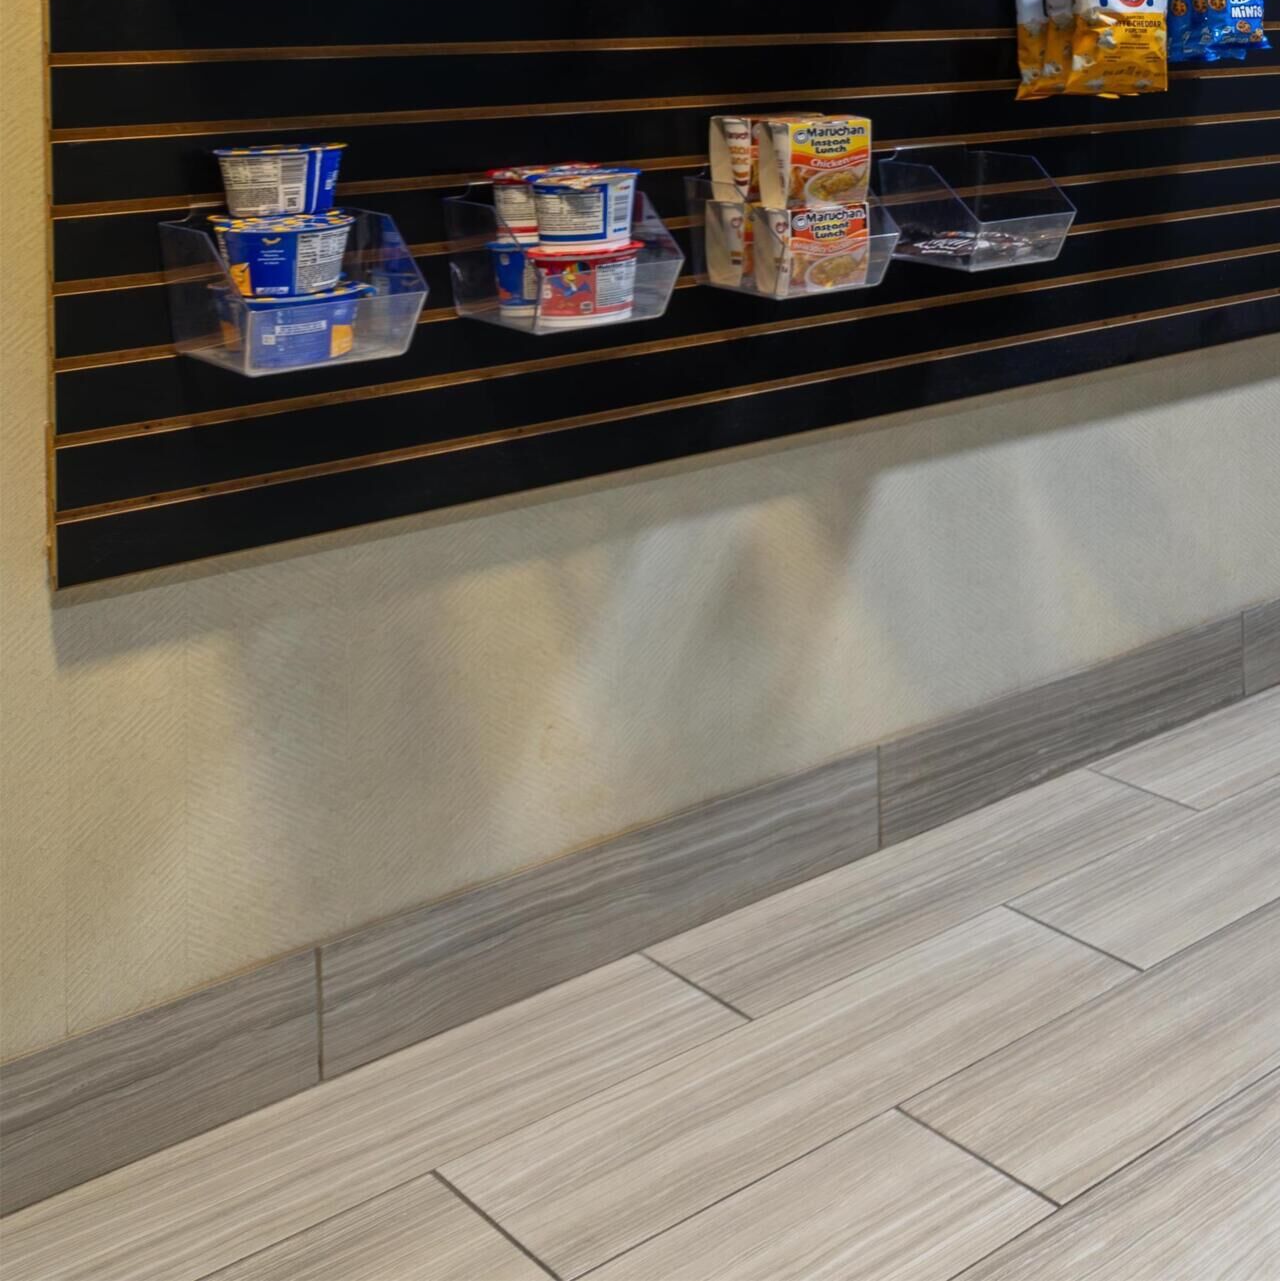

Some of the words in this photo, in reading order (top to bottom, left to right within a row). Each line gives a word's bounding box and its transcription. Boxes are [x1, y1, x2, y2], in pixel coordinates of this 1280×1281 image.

[807, 125, 865, 139] Maruchan
[810, 138, 851, 147] Instant
[815, 145, 847, 155] Lunch
[810, 157, 850, 168] Chicken
[805, 208, 864, 222] Maruchan
[810, 221, 850, 231] Instant
[814, 229, 845, 239] Lunch
